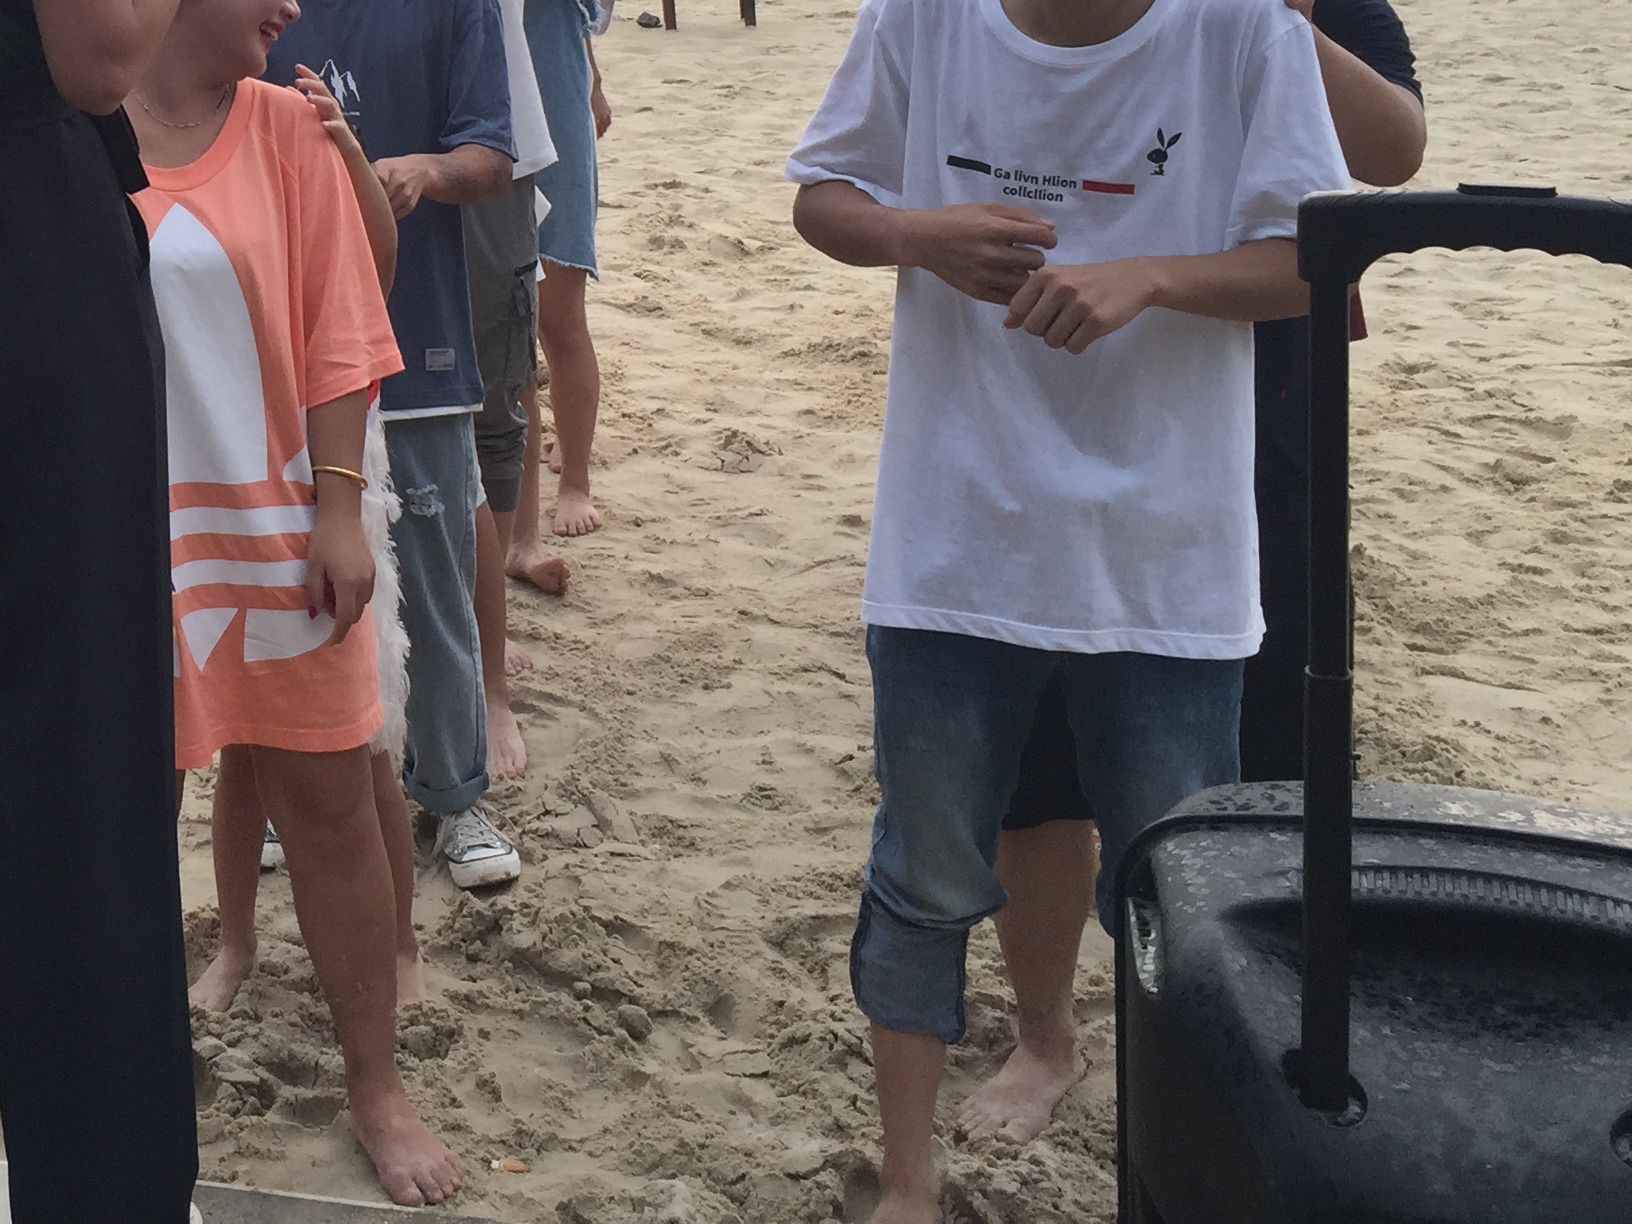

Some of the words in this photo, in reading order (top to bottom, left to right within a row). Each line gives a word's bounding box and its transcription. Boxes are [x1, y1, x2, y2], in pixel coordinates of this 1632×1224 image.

[993, 167, 1011, 180] Ga
[1014, 169, 1039, 186] livn
[1042, 175, 1077, 189] Hlion
